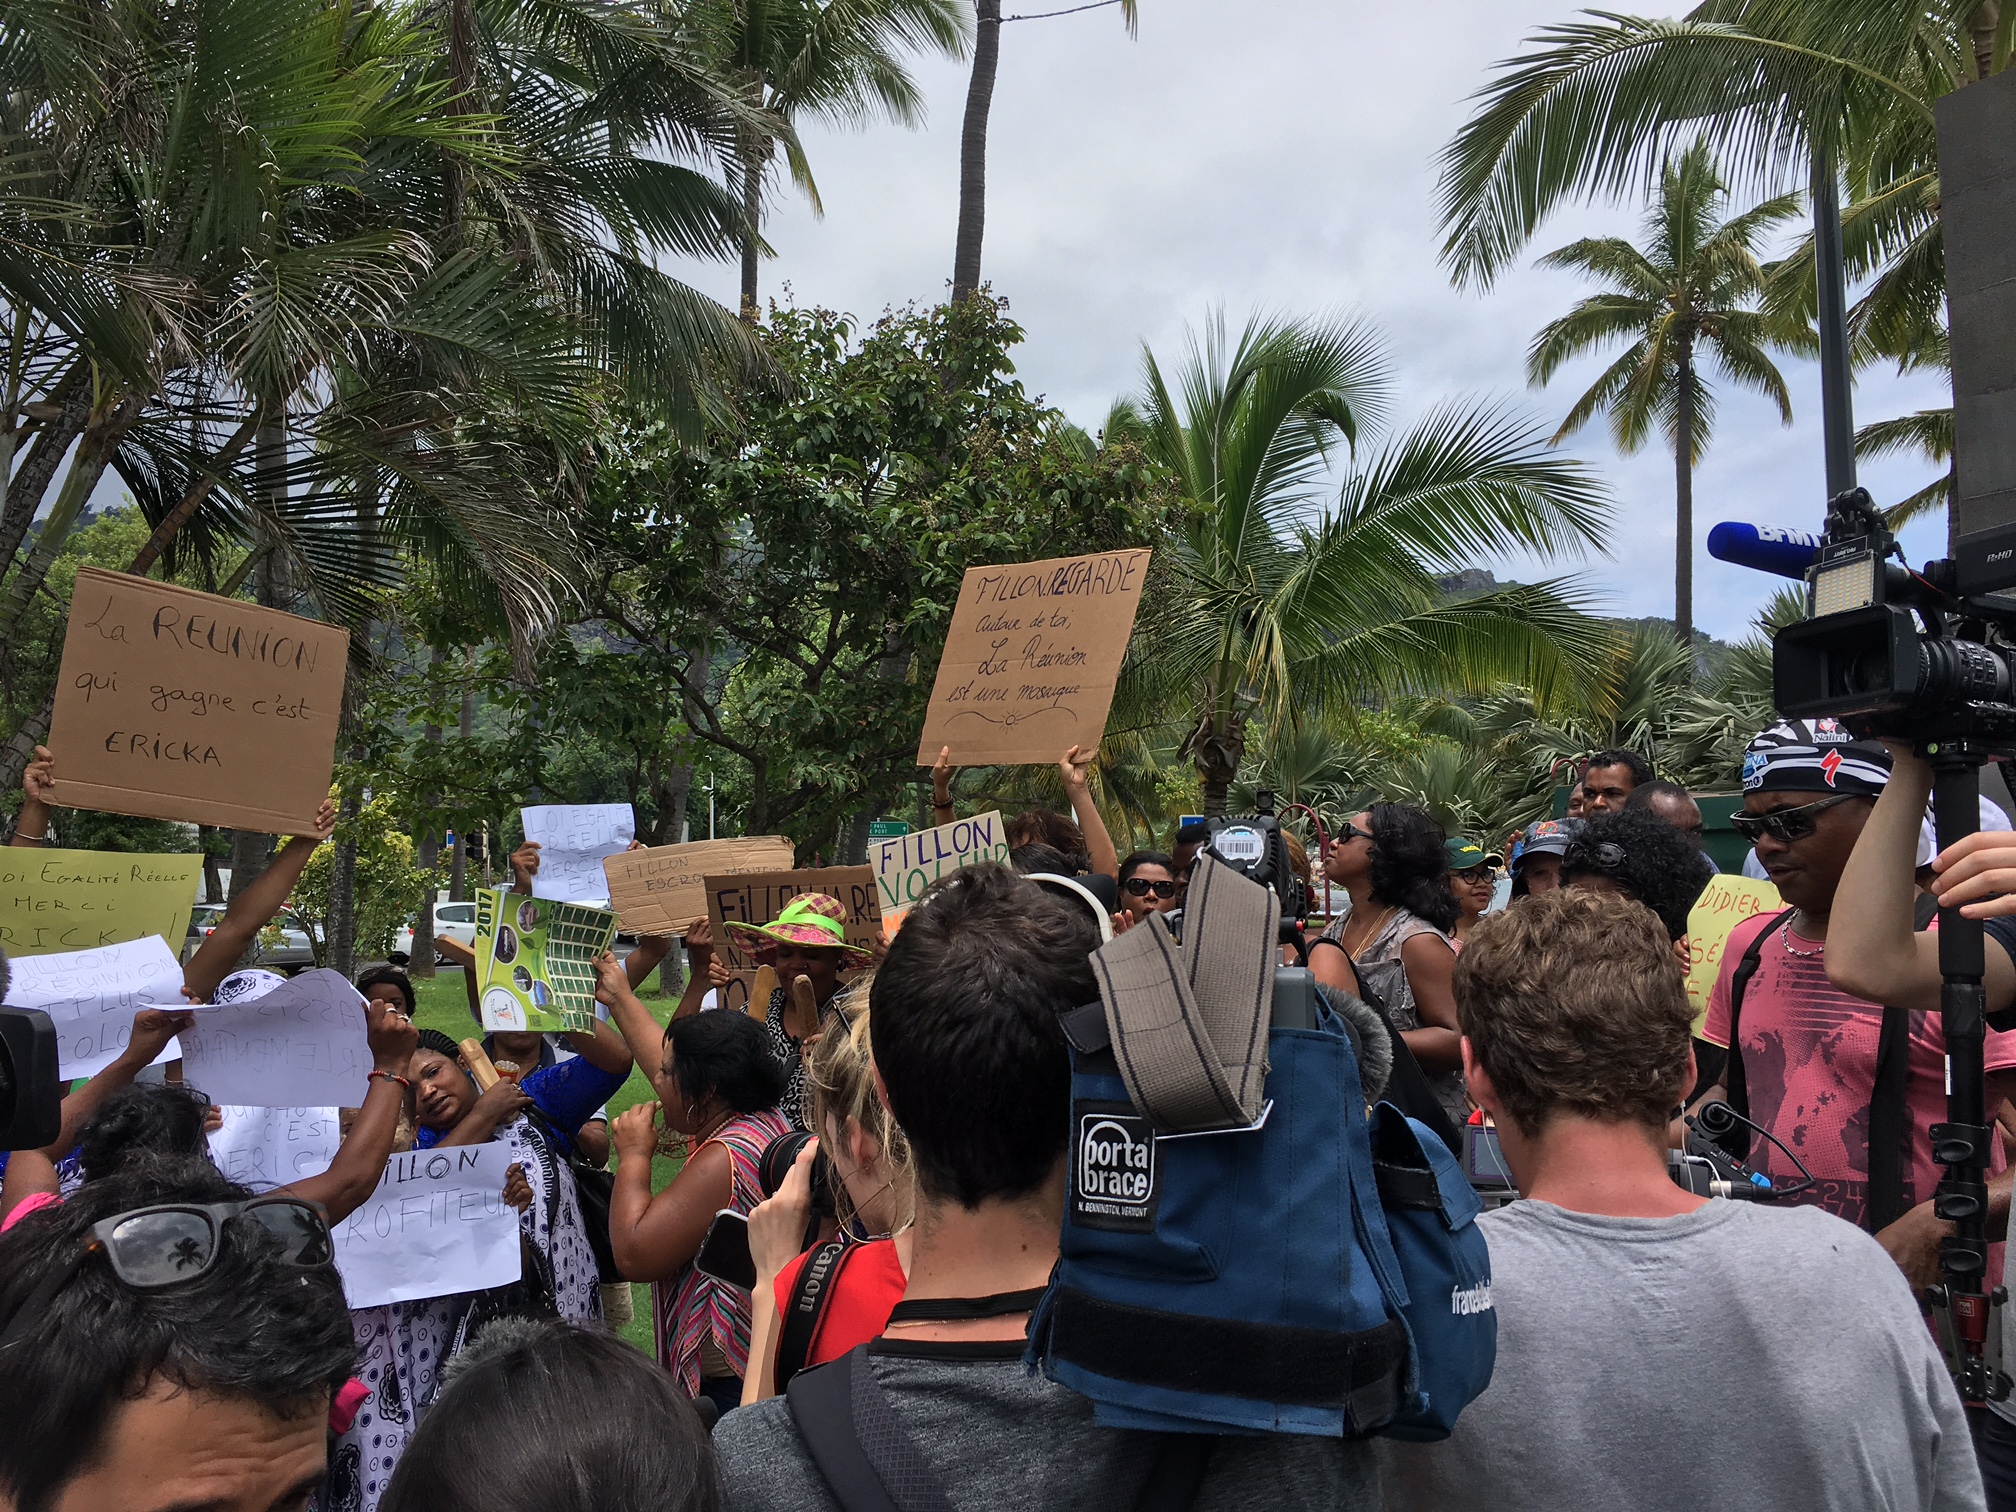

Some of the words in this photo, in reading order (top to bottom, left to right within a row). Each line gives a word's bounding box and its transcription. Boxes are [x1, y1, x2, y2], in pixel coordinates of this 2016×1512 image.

[1759, 525, 1822, 548] BFMT
[84, 596, 129, 644] La
[1026, 610, 1047, 629] de
[978, 637, 1009, 676] La
[75, 671, 118, 702] qui
[150, 684, 236, 715] gagne
[252, 694, 310, 720] c'est
[946, 680, 975, 703] est
[973, 687, 1009, 702] une
[1813, 732, 1848, 743] Nalini
[881, 817, 992, 875] FILLON
[2, 872, 26, 884] OI
[623, 856, 689, 879] FILLON
[567, 873, 607, 894] ERI
[477, 892, 494, 938] 2017
[14, 948, 123, 978] ILLON
[73, 985, 155, 1016] PLUS
[1084, 1135, 1148, 1168] porta
[383, 1149, 481, 1187] ILLON
[1084, 1169, 1148, 1197] brace
[346, 1187, 517, 1248] ROFITEUR
[799, 1243, 844, 1312] Canon
